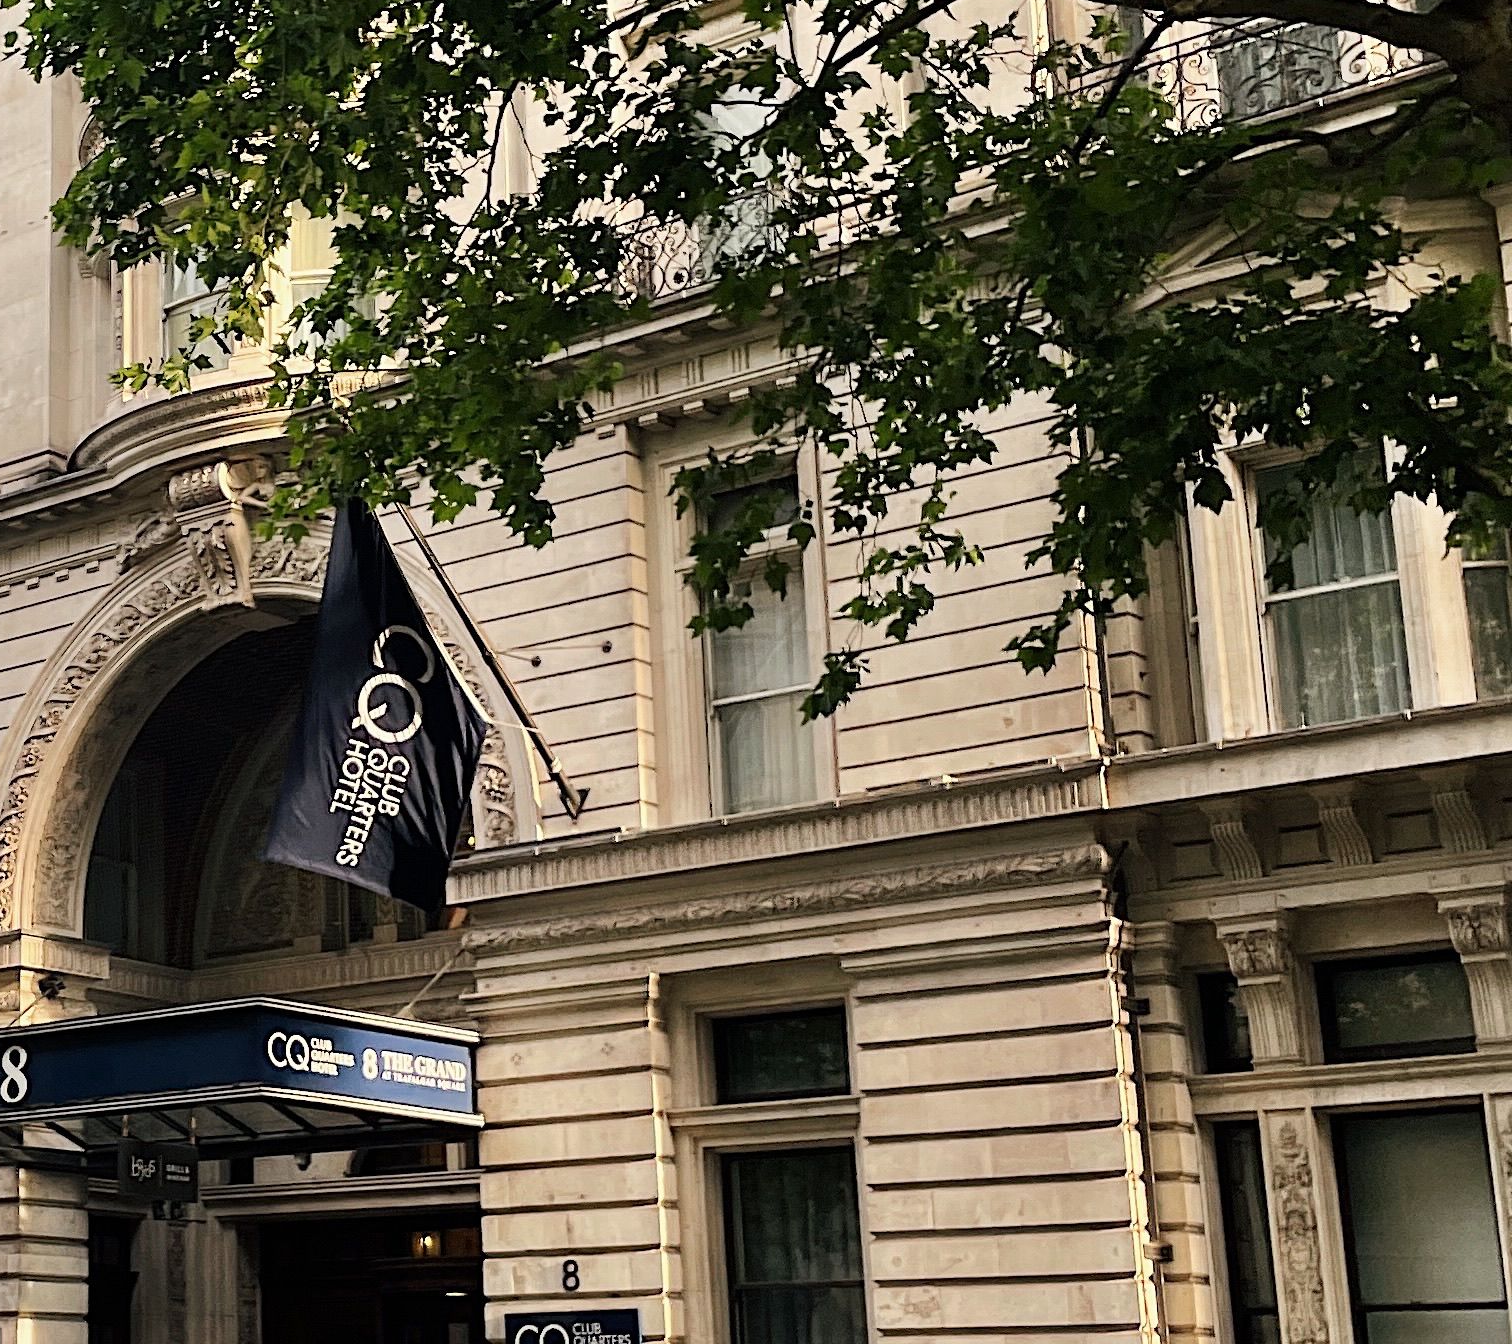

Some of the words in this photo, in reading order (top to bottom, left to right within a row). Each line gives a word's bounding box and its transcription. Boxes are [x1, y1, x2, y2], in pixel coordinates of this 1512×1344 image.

[352, 625, 435, 744] CQ
[329, 738, 370, 814] HOTEL
[377, 753, 411, 817] CLUB
[335, 747, 388, 868] QUARTERS
[0, 1045, 27, 1103] 8
[267, 1031, 309, 1071] CQ
[362, 1048, 379, 1080] 8
[381, 1050, 413, 1074] THE
[414, 1056, 468, 1081] GRAND
[562, 1259, 580, 1291] 8
[572, 1322, 602, 1336] CLUB
